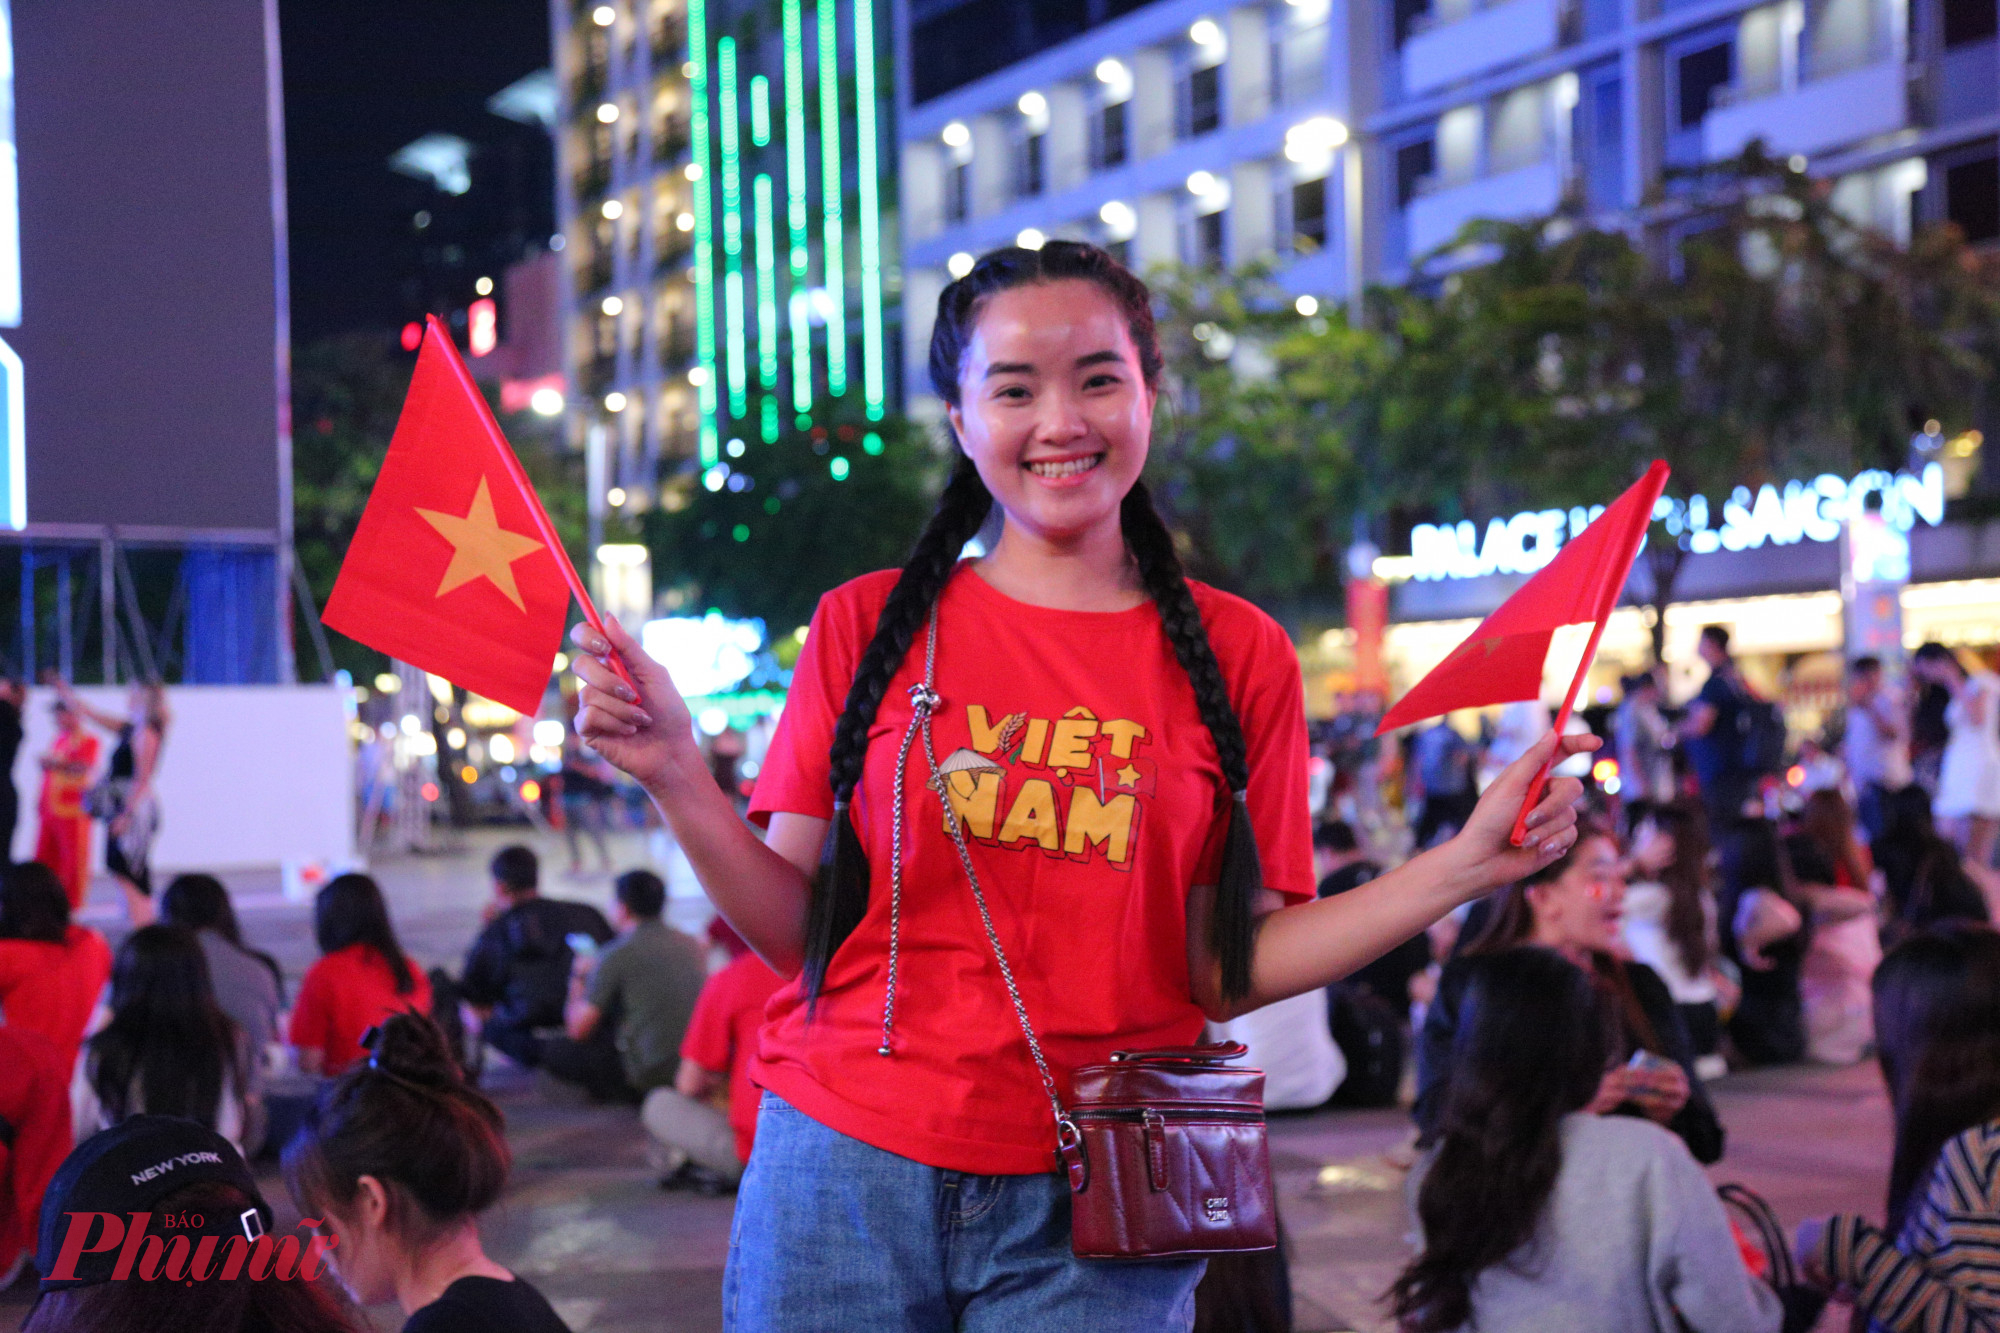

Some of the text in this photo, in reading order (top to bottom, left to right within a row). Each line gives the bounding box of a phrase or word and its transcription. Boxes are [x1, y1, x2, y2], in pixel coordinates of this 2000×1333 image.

[966, 704, 1153, 787] VIỆT
[131, 1151, 223, 1186] NEW YORK
